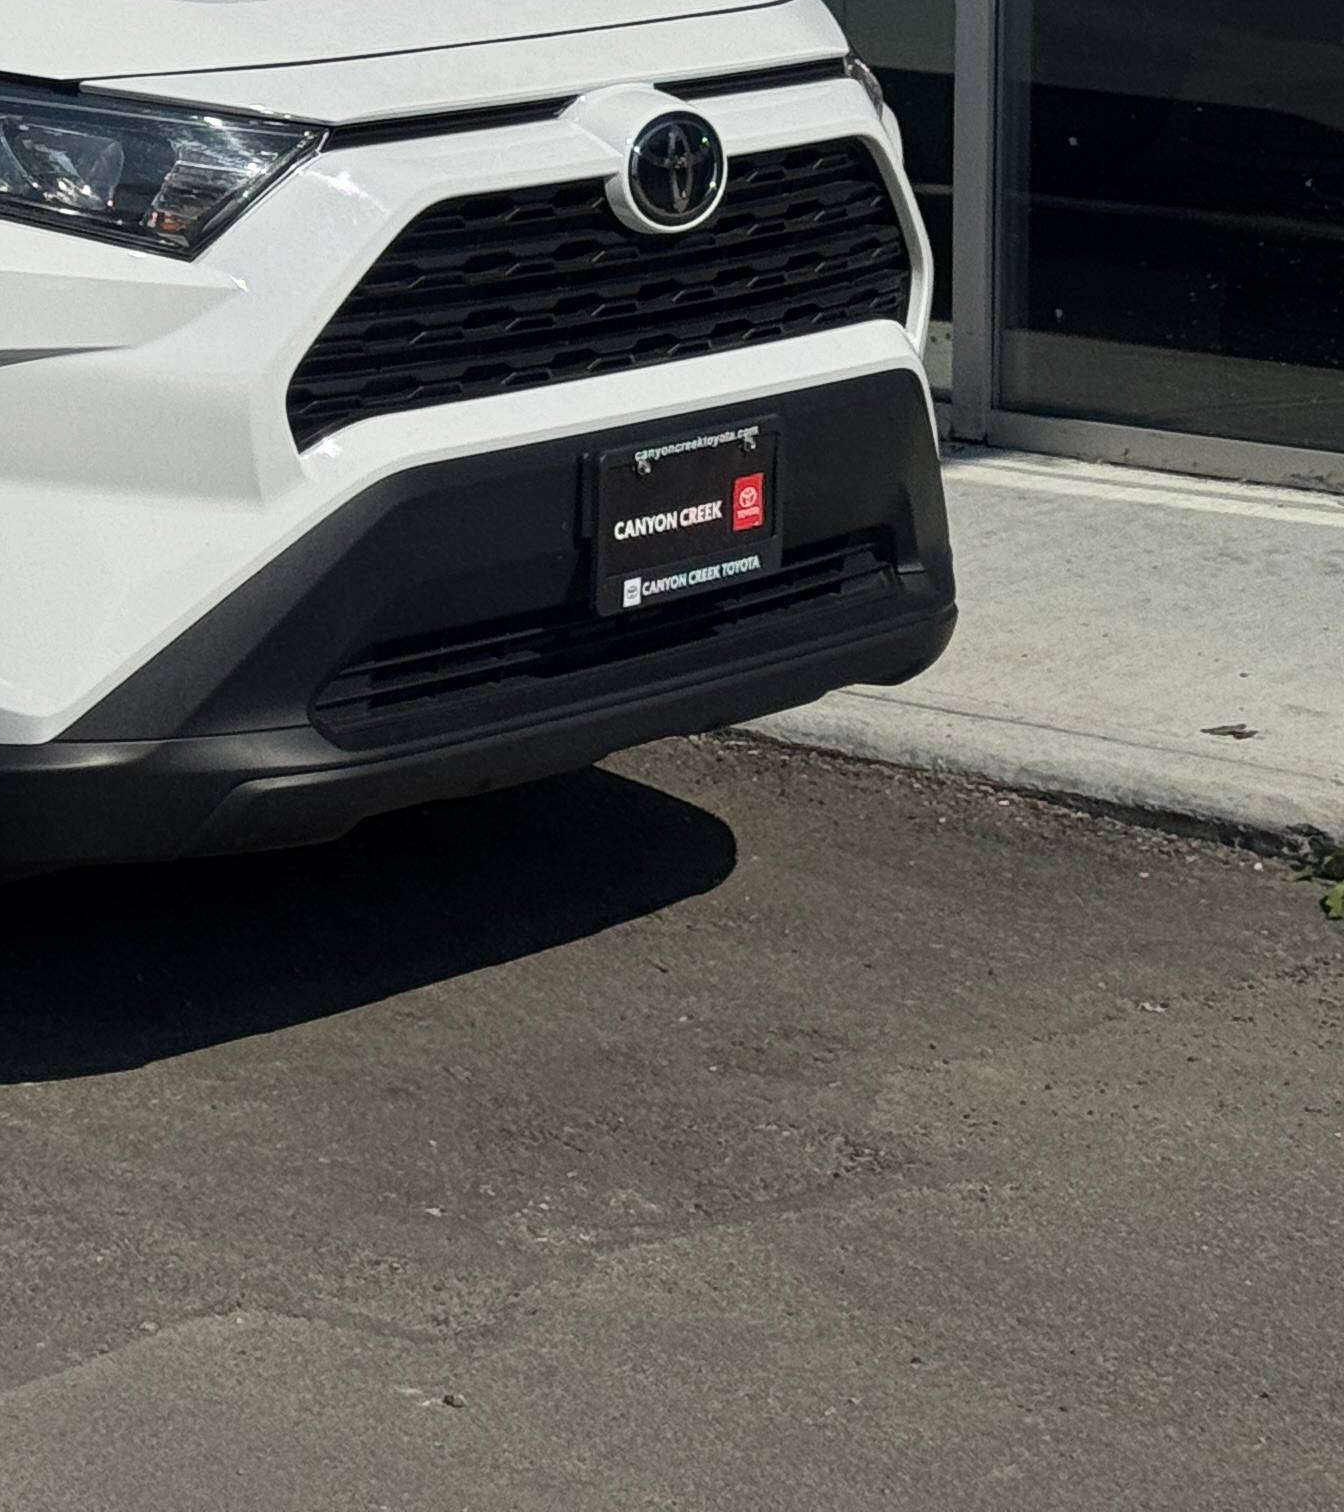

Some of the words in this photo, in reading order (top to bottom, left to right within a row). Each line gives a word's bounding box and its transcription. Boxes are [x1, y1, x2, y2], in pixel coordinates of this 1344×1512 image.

[614, 510, 678, 540] CANYON
[679, 500, 723, 528] CREEK
[642, 572, 687, 596] CANYON
[688, 564, 721, 585] CREEK
[721, 555, 761, 577] TOYOTA
